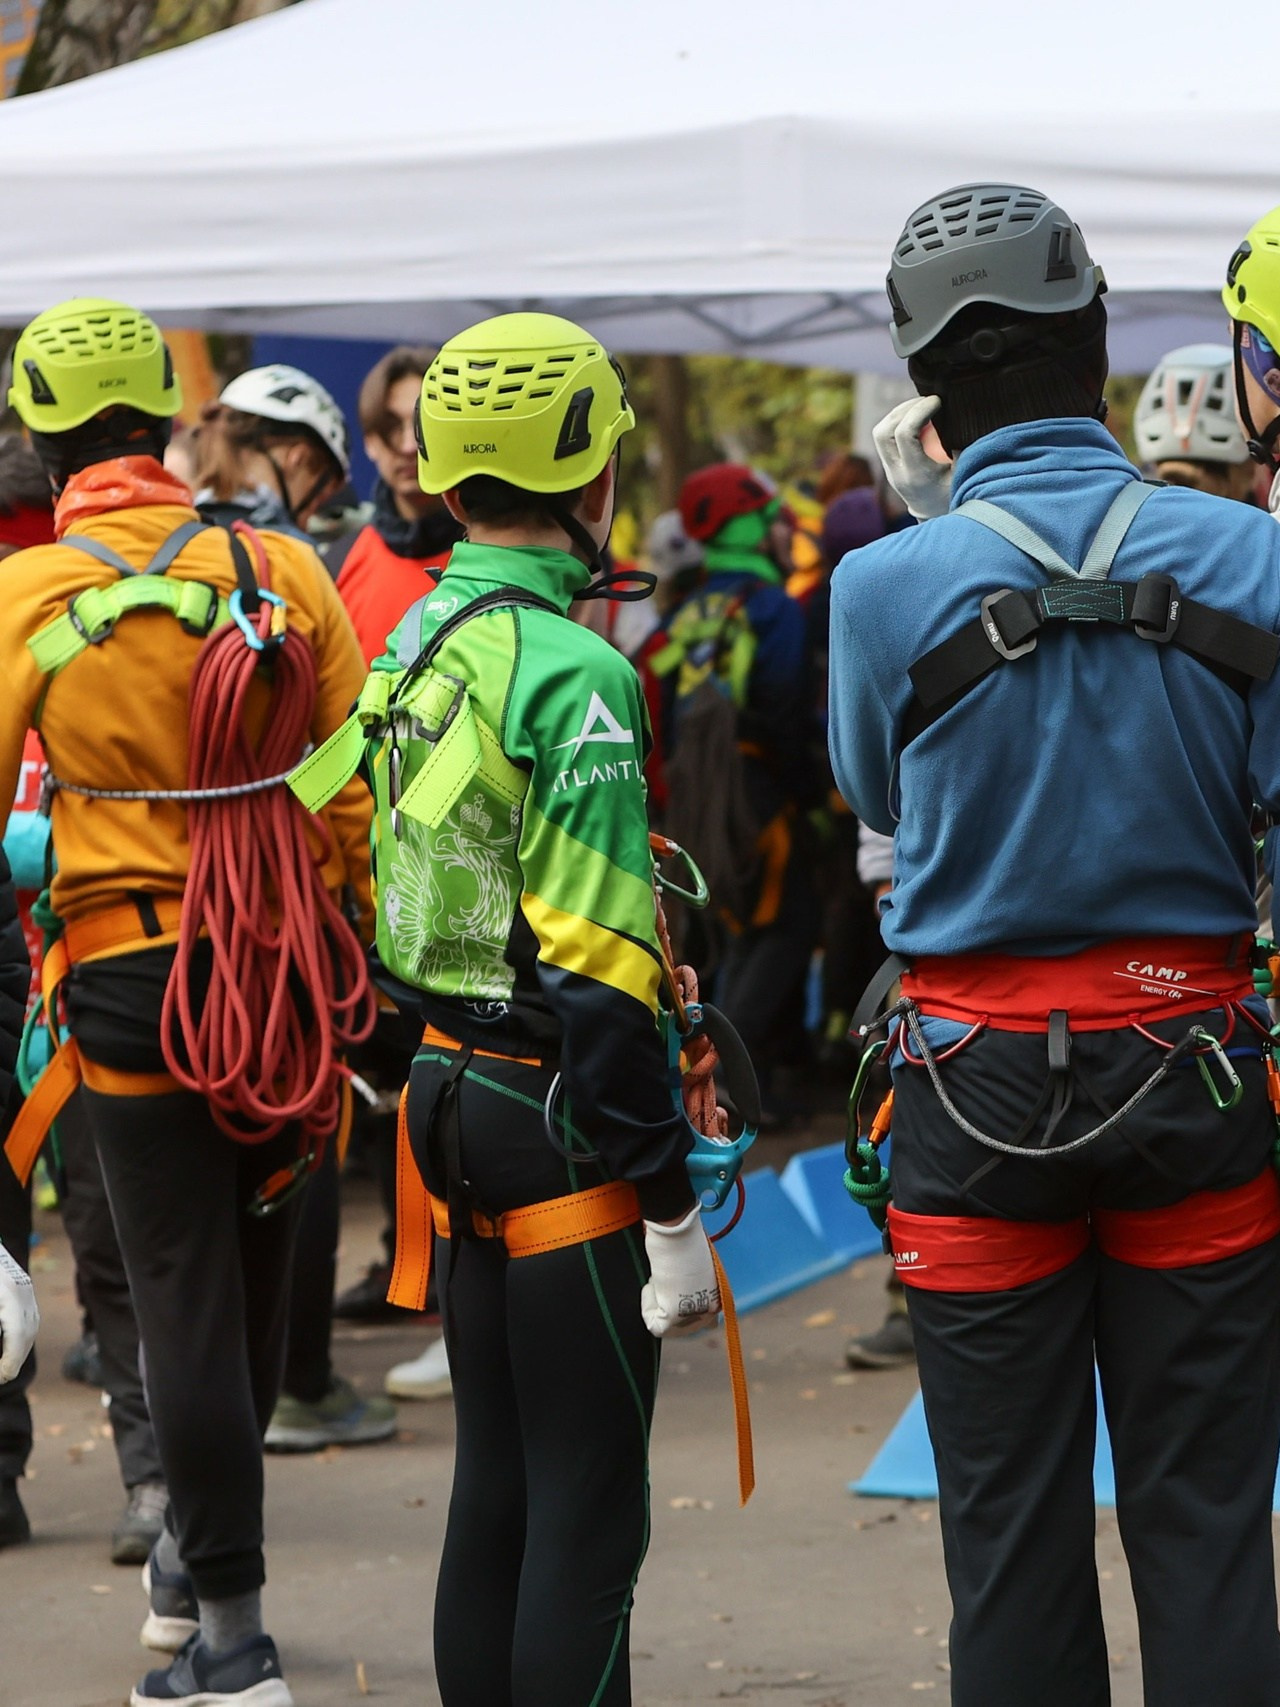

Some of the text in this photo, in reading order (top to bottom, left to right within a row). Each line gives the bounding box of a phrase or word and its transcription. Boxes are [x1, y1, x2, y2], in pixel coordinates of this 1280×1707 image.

[951, 268, 988, 288] AURORA
[463, 443, 498, 454] AURORA
[1126, 961, 1187, 982] CAMP
[1140, 984, 1168, 996] ENERGY
